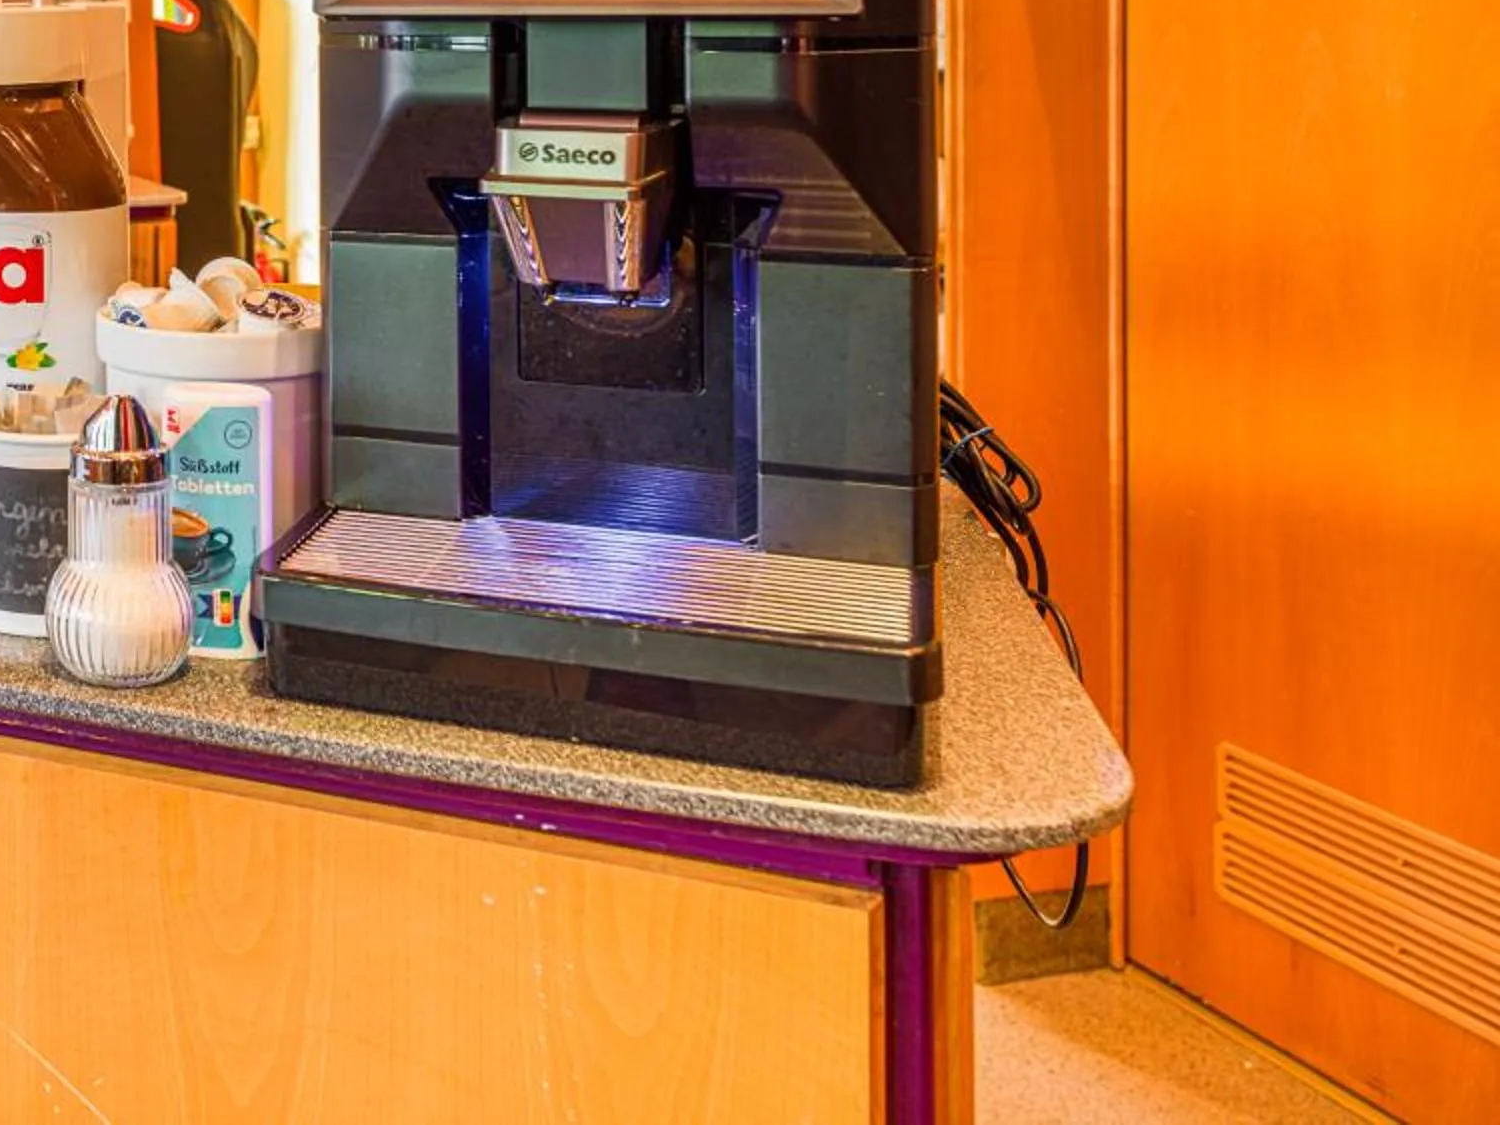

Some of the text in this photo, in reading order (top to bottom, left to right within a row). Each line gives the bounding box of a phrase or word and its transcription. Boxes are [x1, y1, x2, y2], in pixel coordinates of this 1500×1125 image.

[541, 143, 616, 165] Saeco
[179, 456, 240, 475] Süßstoff
[170, 475, 255, 495] Tabletten
